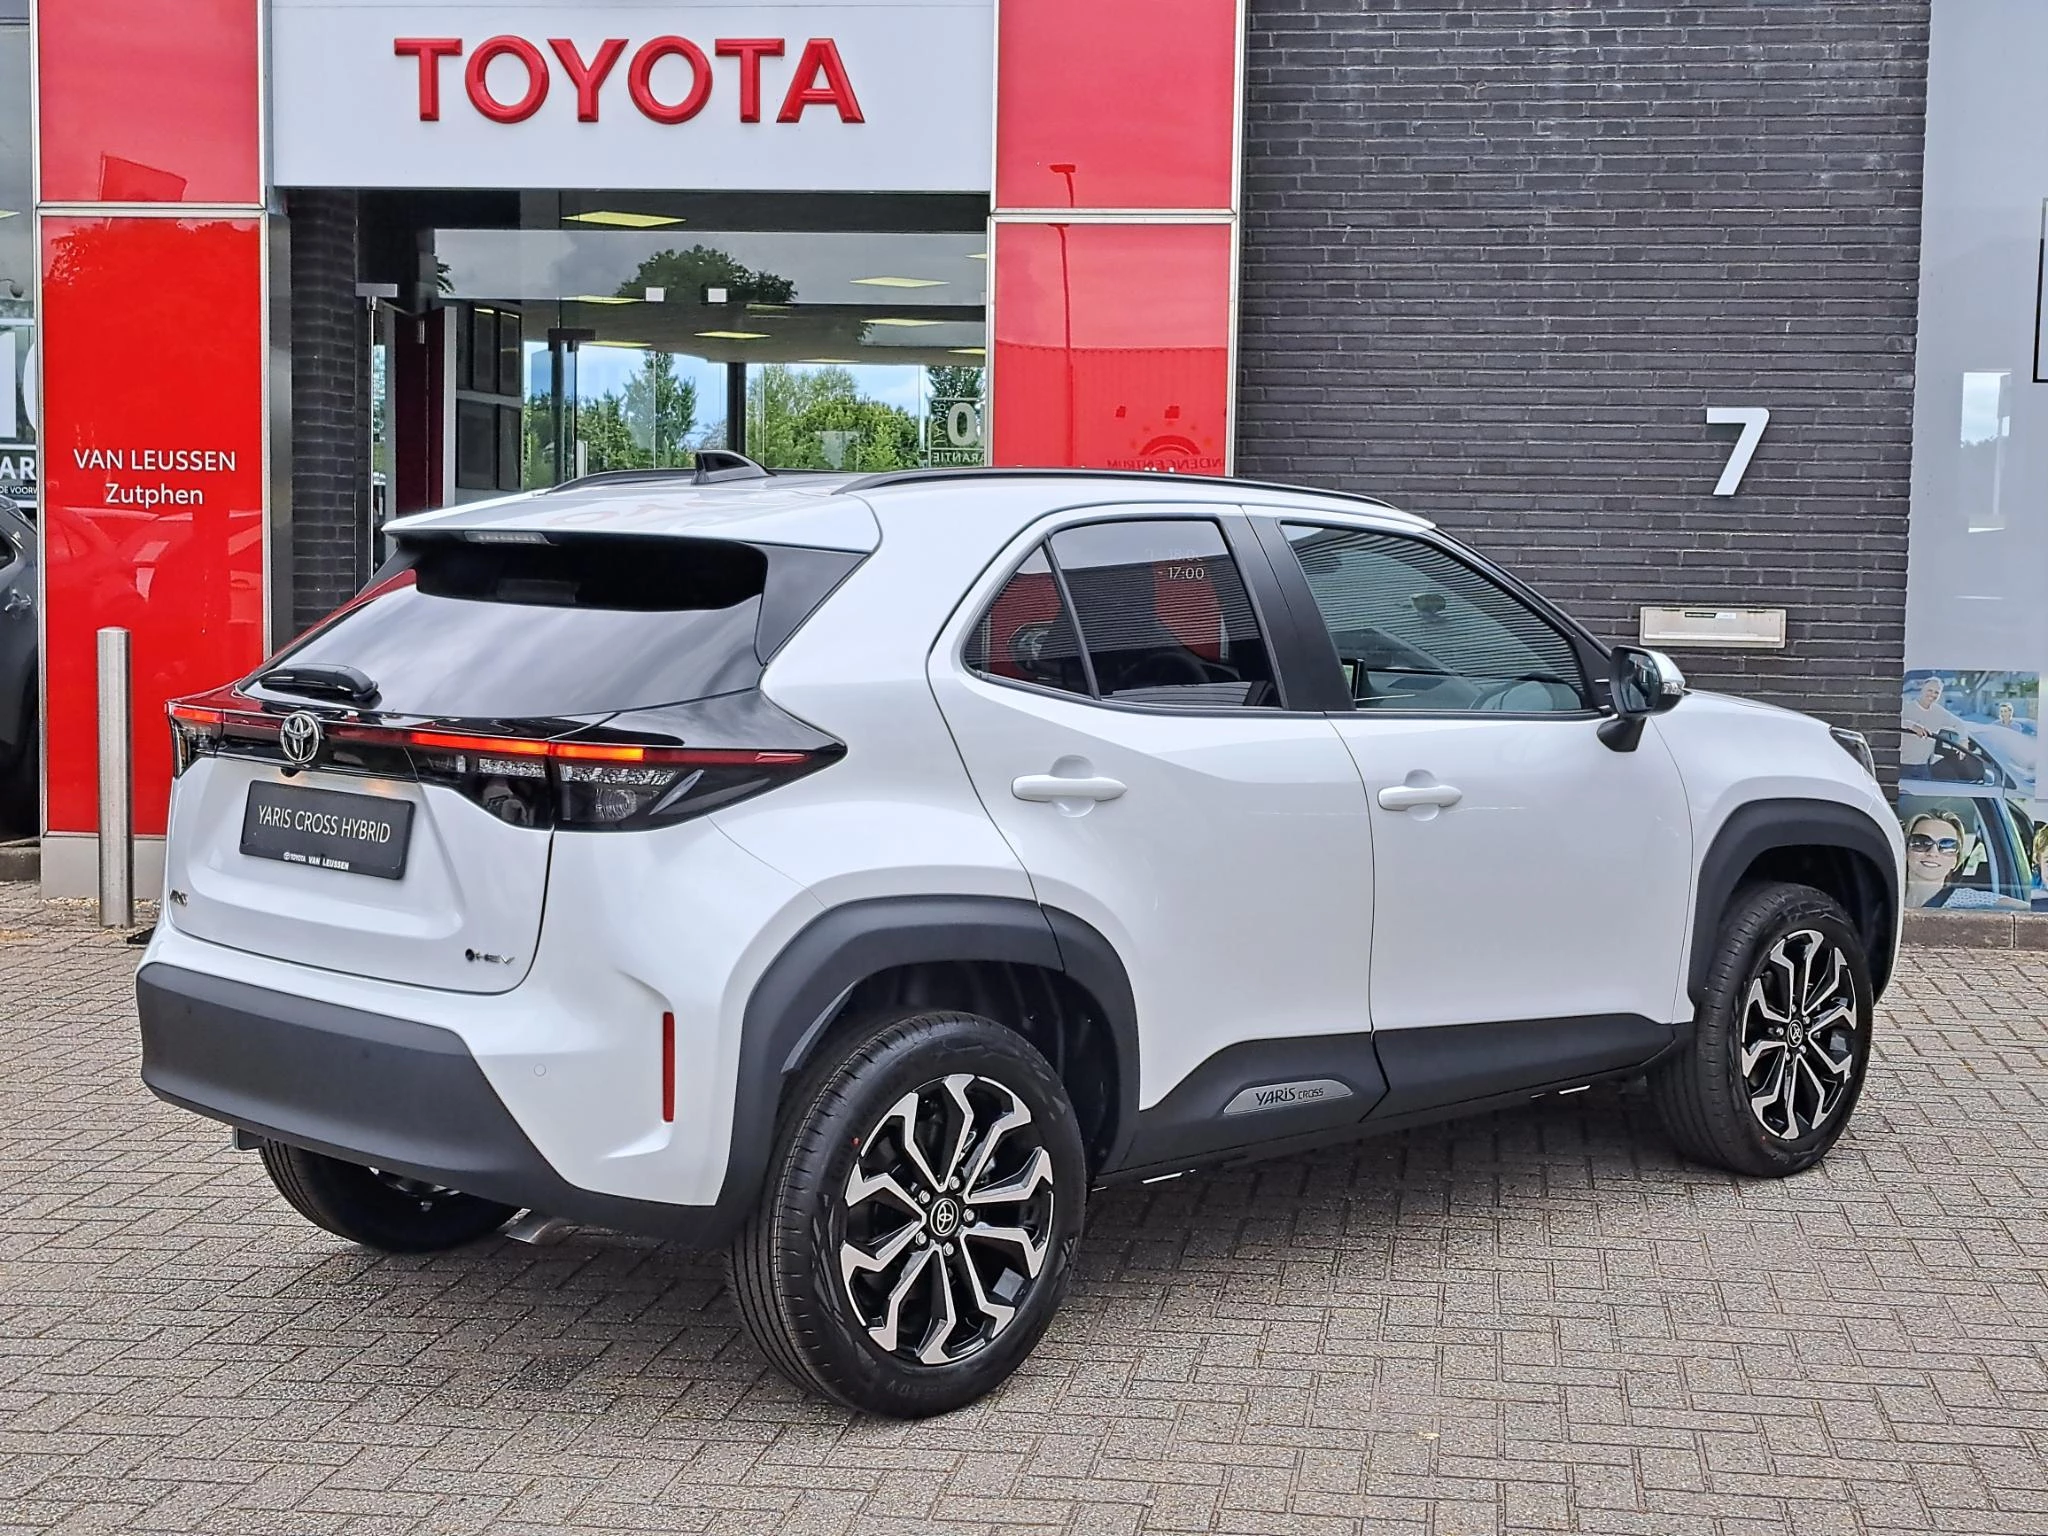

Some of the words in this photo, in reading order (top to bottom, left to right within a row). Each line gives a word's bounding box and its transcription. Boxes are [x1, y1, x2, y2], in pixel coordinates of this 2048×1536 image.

[394, 35, 866, 124] TOYOTA
[73, 448, 123, 470] VAN
[131, 450, 237, 472] LEUSSEN
[1706, 407, 1770, 496] 7
[105, 483, 204, 509] Zutphen
[1167, 566, 1205, 580] 17:00
[258, 804, 293, 829] YARIS
[295, 810, 339, 836] CROSS
[341, 817, 391, 844] HYBRID
[308, 856, 321, 866] VAN
[322, 858, 350, 871] LEUSSEN
